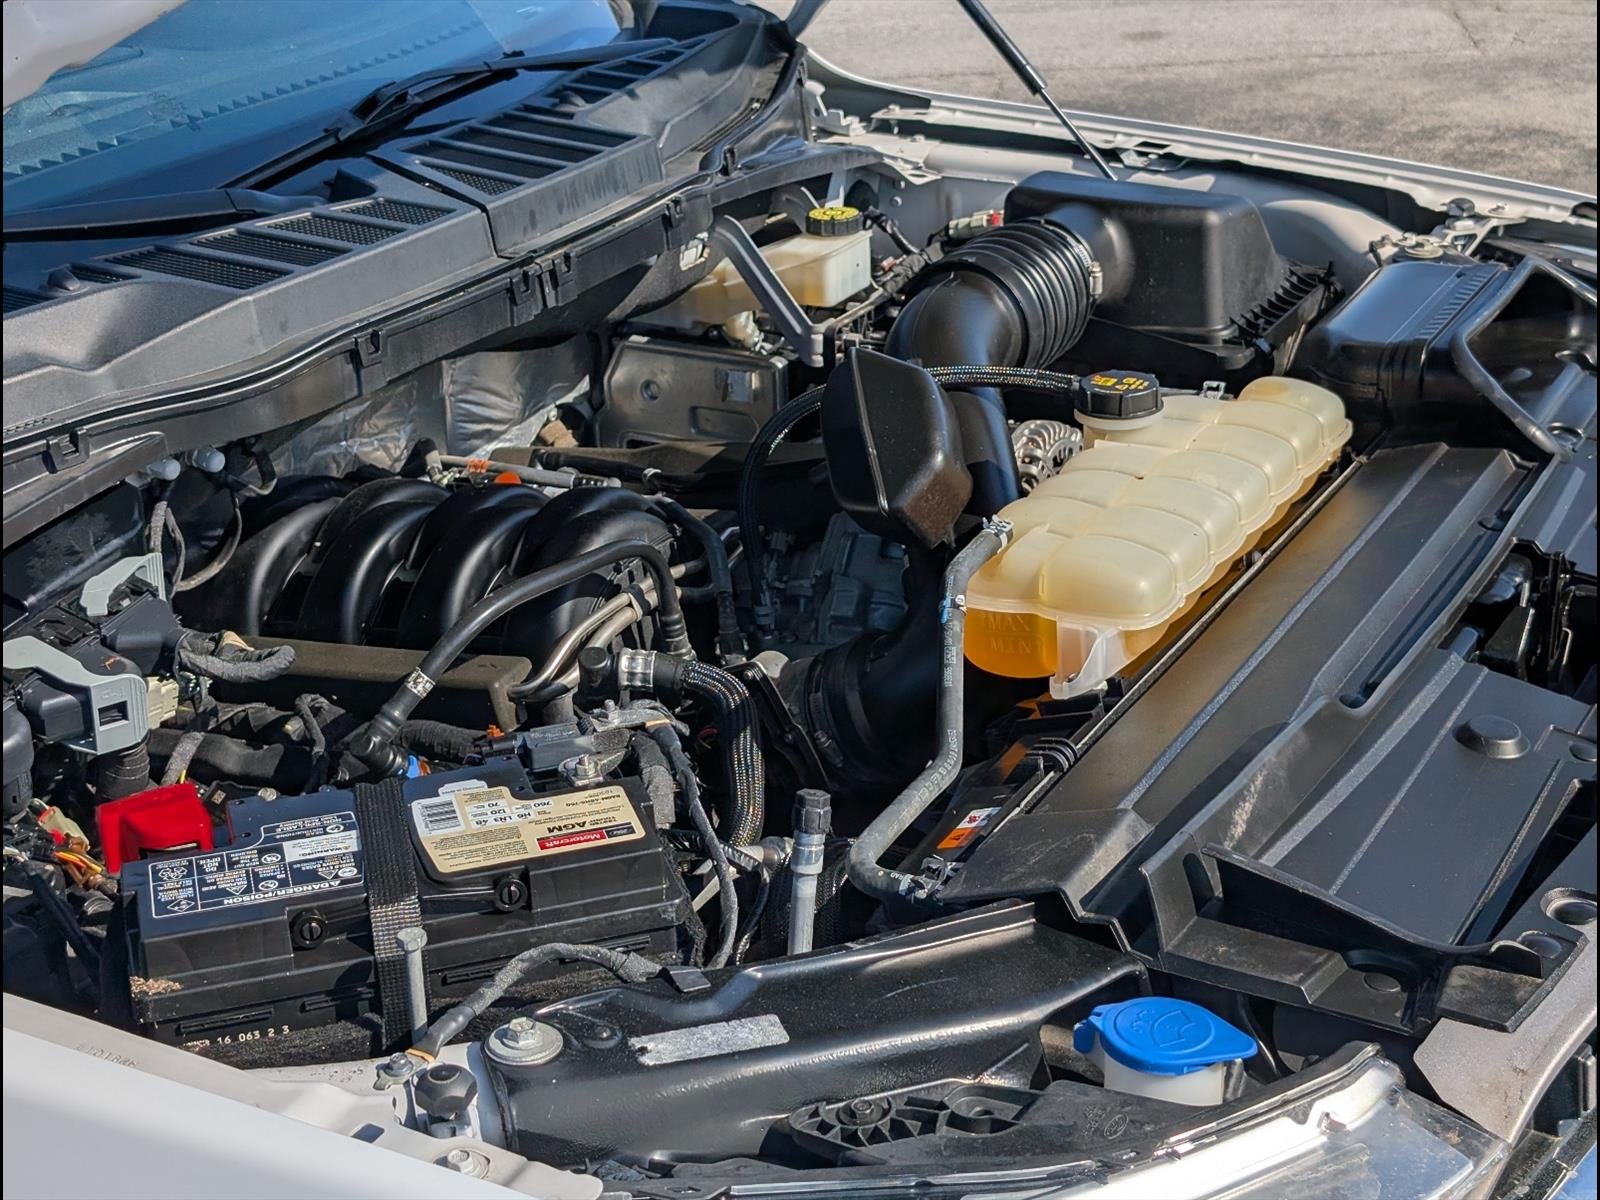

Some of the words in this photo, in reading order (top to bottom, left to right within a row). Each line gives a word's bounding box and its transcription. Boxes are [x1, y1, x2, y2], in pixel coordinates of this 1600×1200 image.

[986, 614, 1030, 632] MAX
[990, 638, 1031, 654] MIN
[547, 821, 586, 833] AGM
[544, 832, 600, 848] Motorcraft
[223, 882, 329, 904] DANGER/POISON
[217, 1036, 231, 1045] 16
[238, 1030, 260, 1042] 063
[268, 1028, 275, 1037] 2
[282, 1024, 290, 1034] 3
